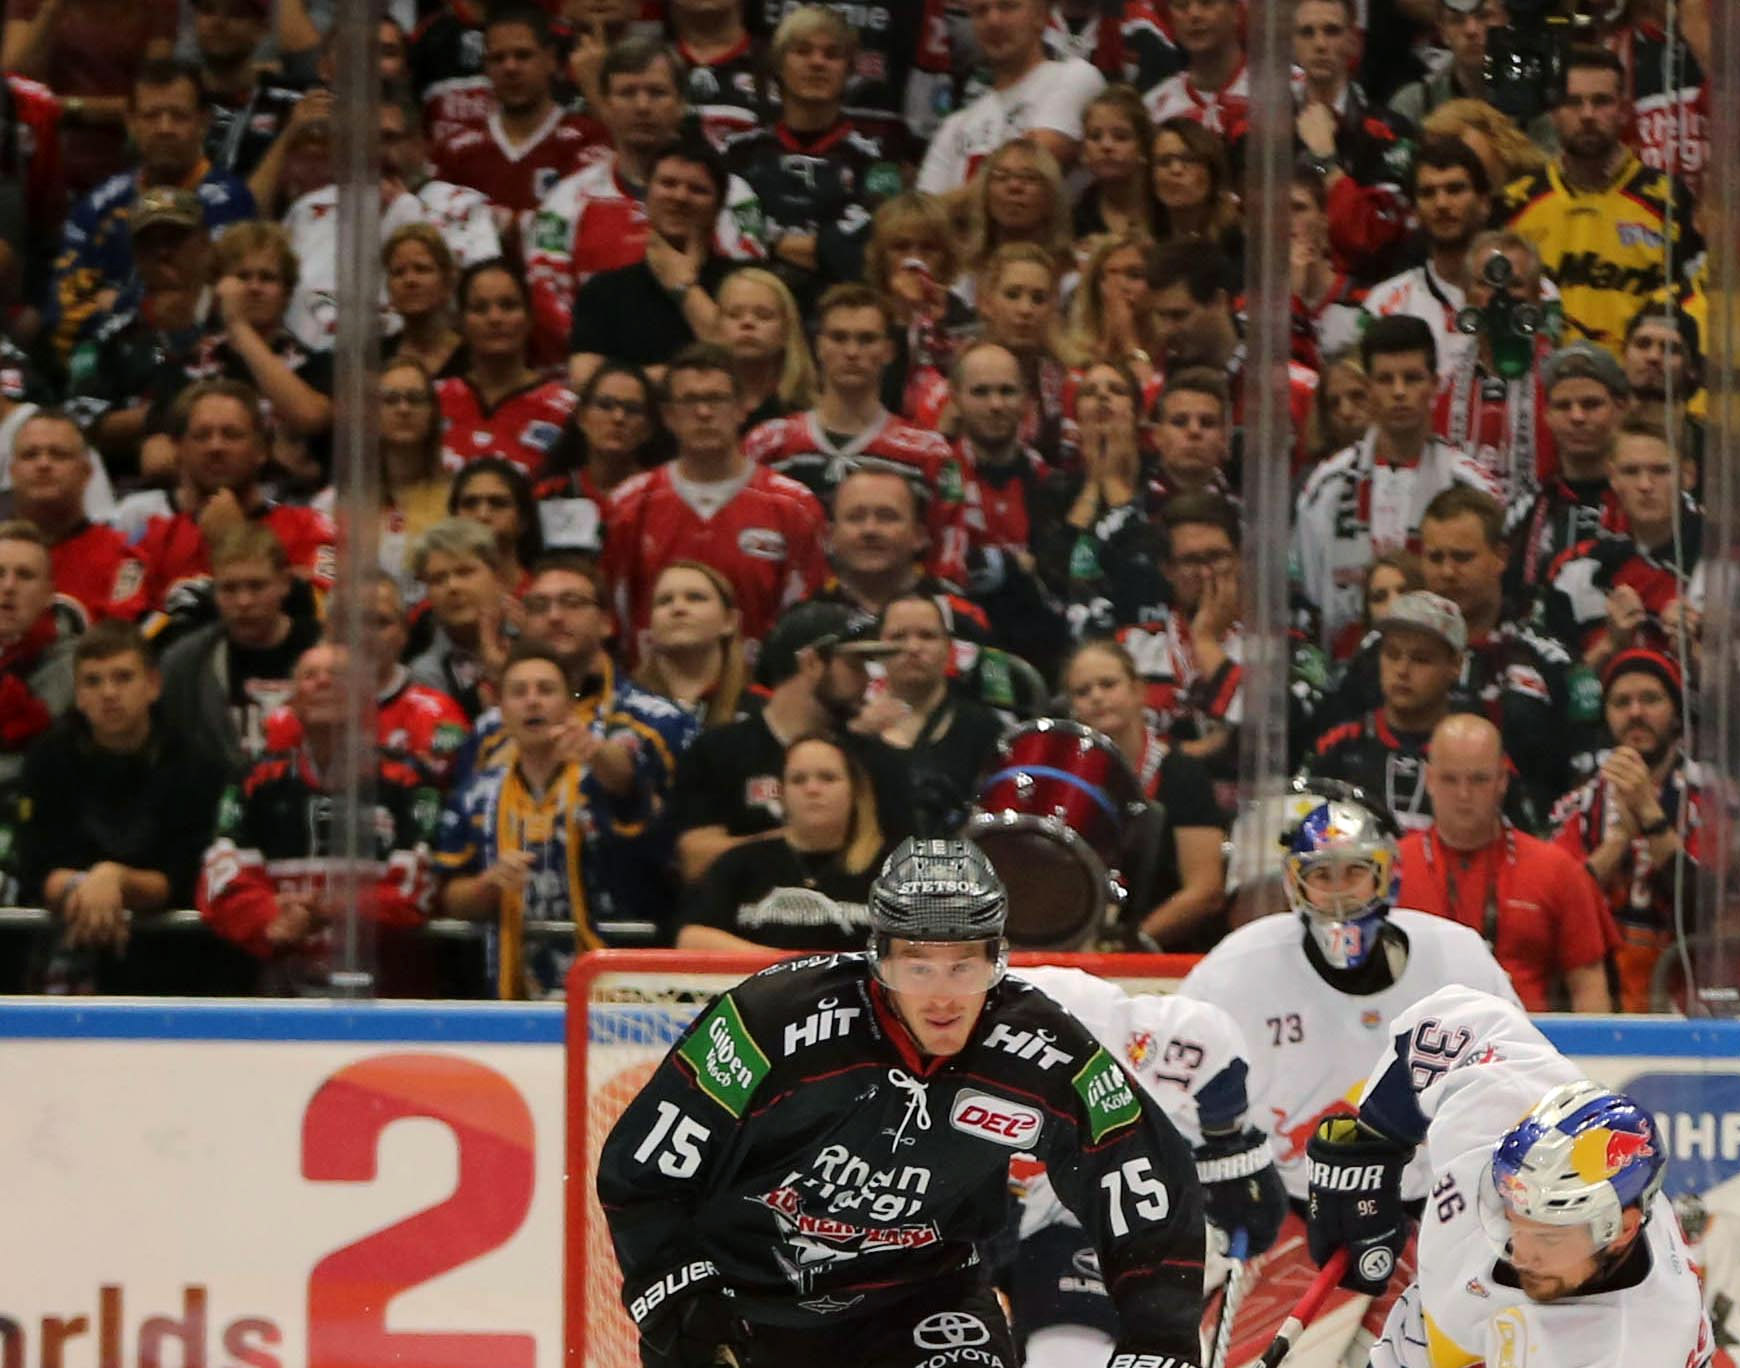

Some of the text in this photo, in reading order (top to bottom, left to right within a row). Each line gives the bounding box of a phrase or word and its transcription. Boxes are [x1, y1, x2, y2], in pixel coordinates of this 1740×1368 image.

[1266, 1013, 1304, 1046] 73
[1156, 1038, 1205, 1092] 13
[633, 1100, 711, 1179] 15
[956, 1104, 1037, 1138] DEL
[1100, 1157, 1170, 1238] 15
[1432, 1172, 1467, 1225] 36
